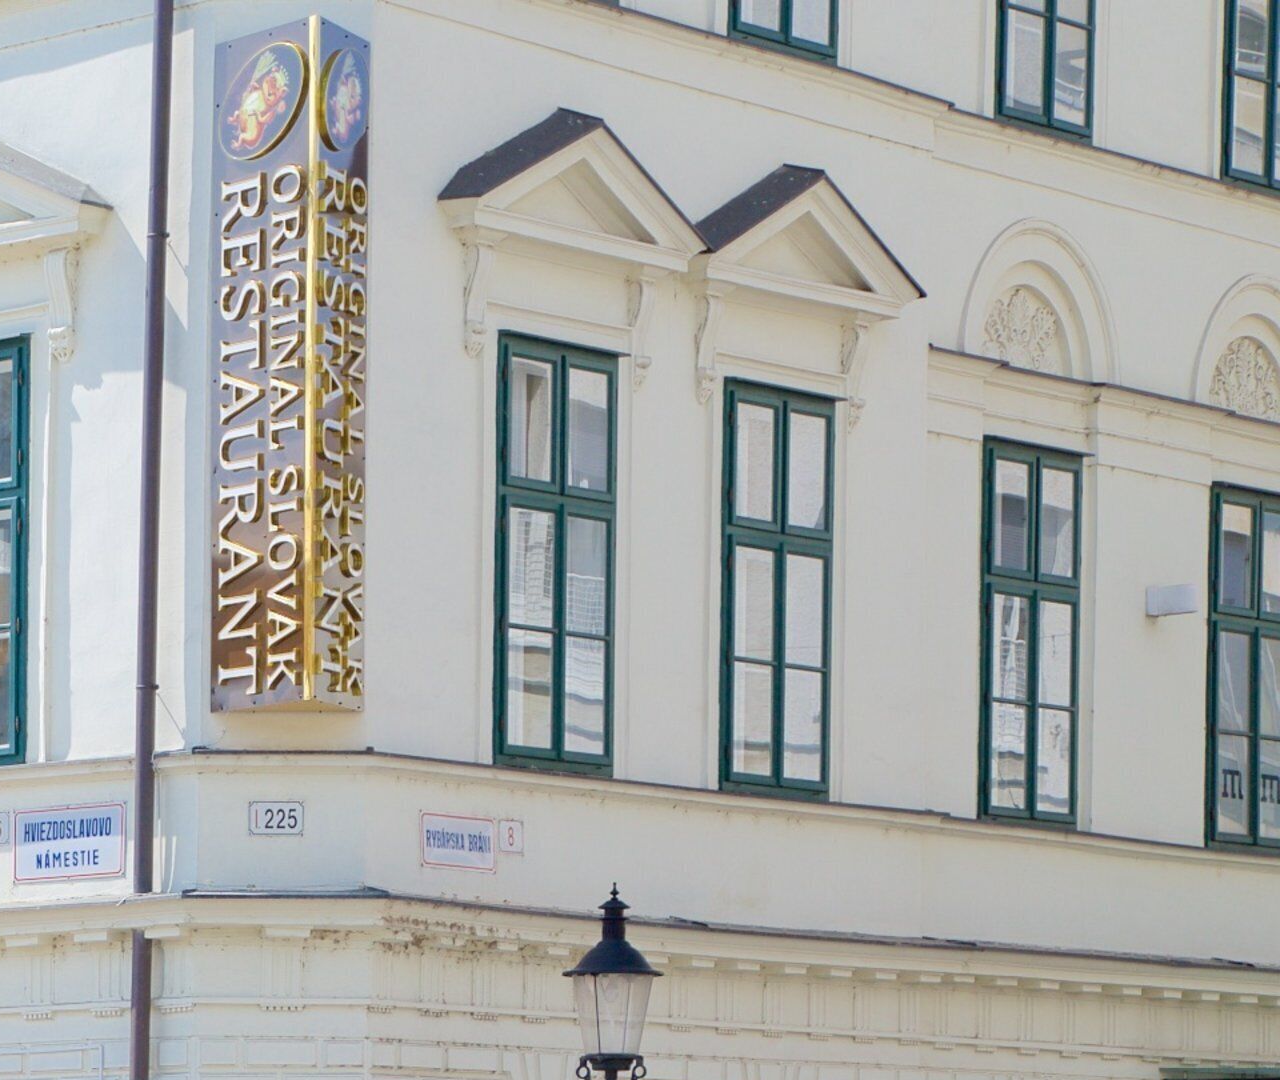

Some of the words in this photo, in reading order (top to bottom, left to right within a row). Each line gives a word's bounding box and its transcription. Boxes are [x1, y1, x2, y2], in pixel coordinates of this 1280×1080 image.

[269, 163, 308, 451] ORIGINAL
[217, 171, 270, 696] RESTAURANT
[266, 464, 306, 692] SLOVAK
[343, 472, 366, 697] SLOVAK
[24, 816, 112, 843] HVIEZDOSLAVOVO
[36, 849, 100, 869] NÁMESTIE
[264, 808, 298, 829] 225
[507, 826, 515, 847] 8
